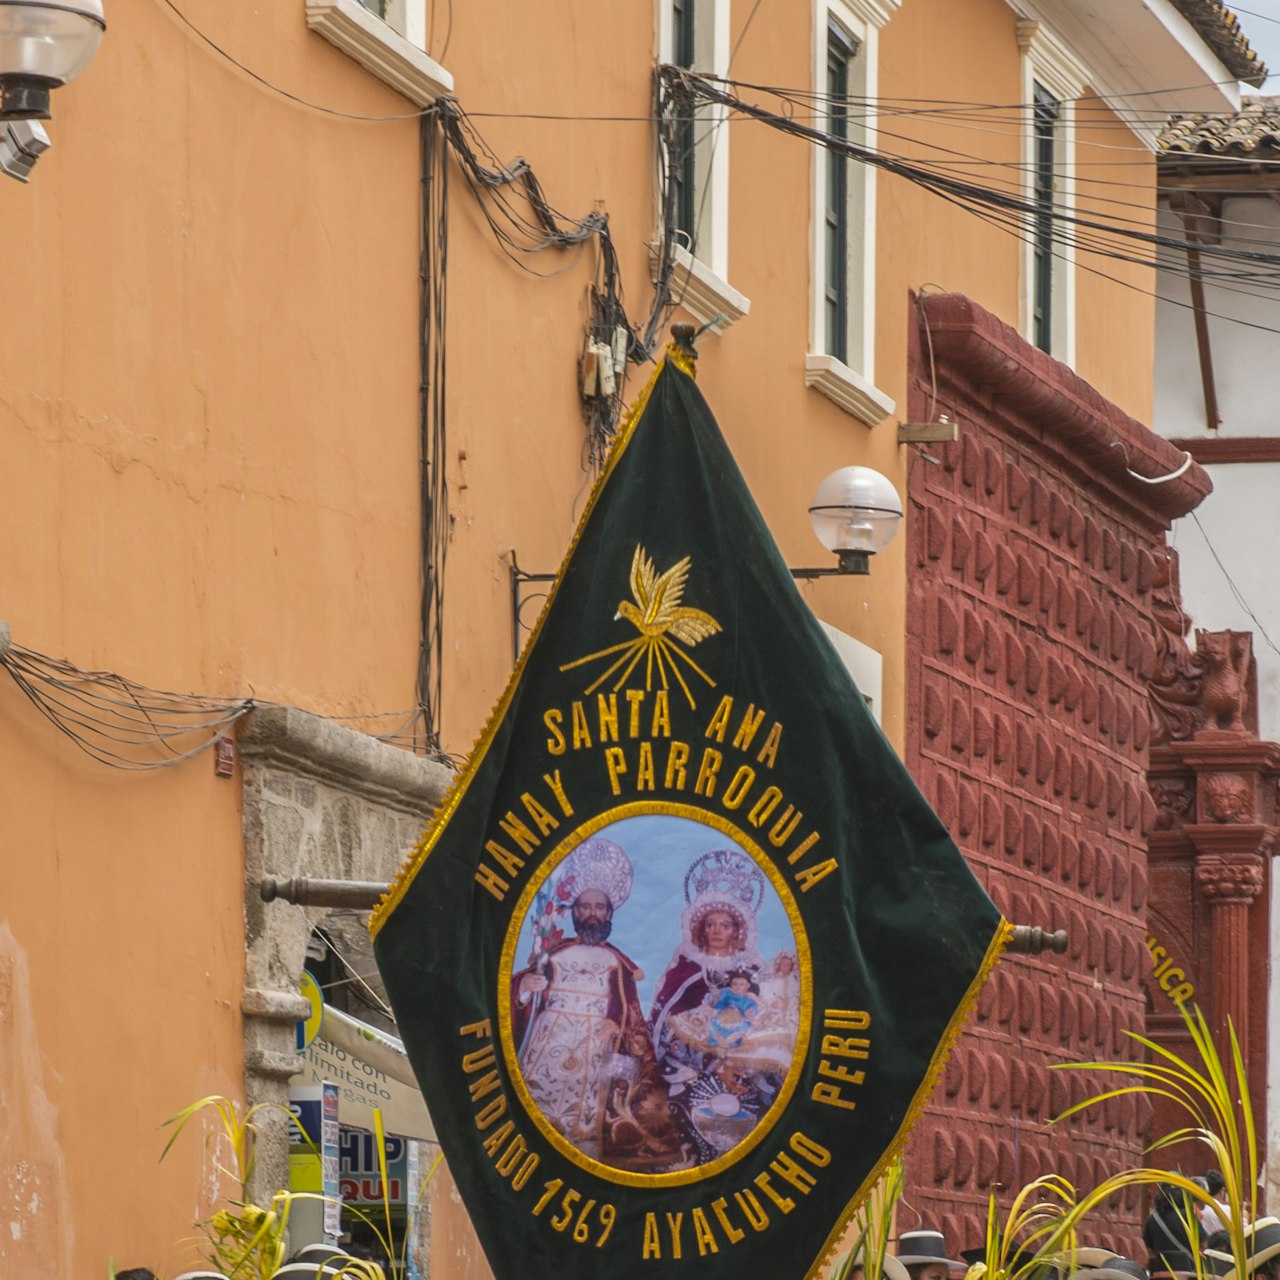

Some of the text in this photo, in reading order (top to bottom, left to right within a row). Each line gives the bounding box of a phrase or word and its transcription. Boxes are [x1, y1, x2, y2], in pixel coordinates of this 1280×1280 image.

[545, 689, 784, 769] SANTA ANA
[475, 741, 840, 902] HANAY PARROQUIA
[352, 1057, 388, 1084] con
[460, 1018, 541, 1192] FUNDADO
[532, 1179, 618, 1249] 1569
[642, 1132, 833, 1261] AYACUCHO
[812, 1009, 872, 1111] PERU
